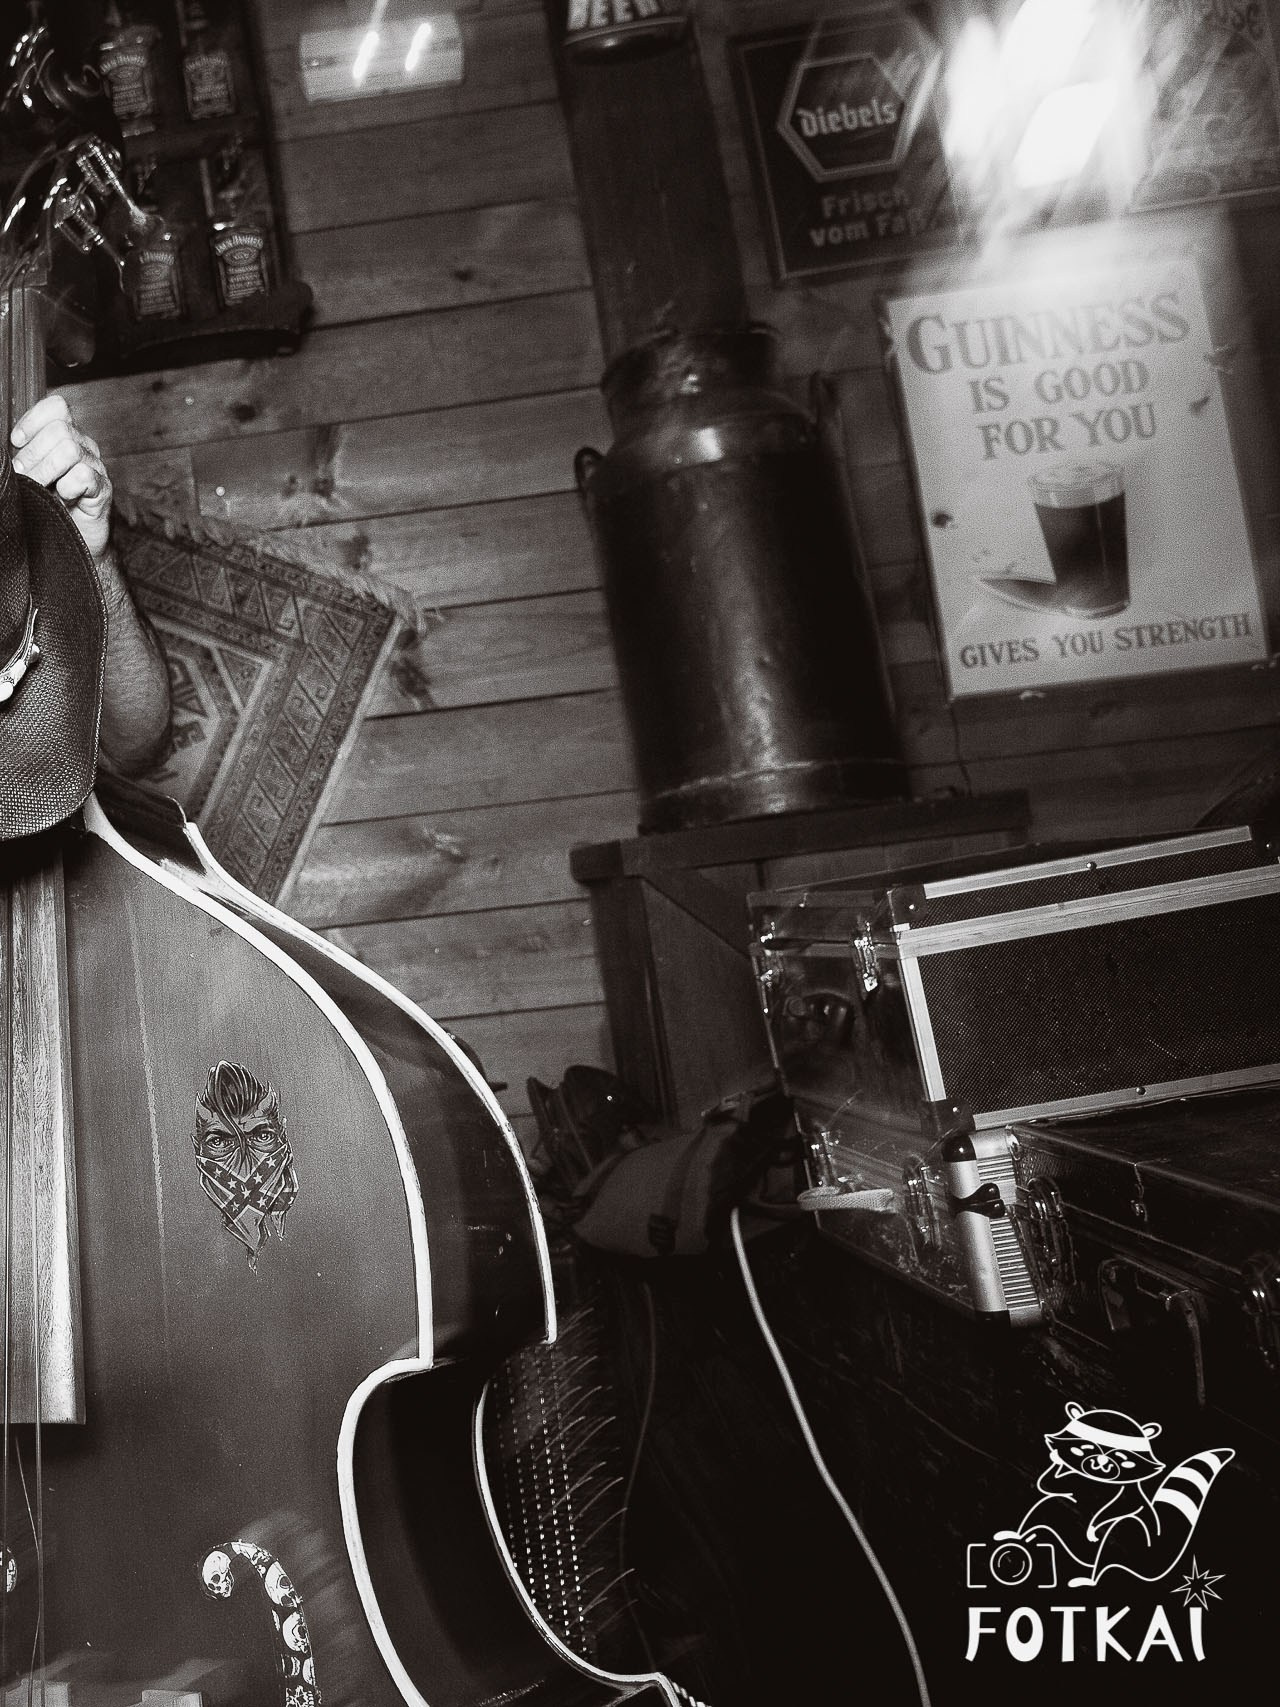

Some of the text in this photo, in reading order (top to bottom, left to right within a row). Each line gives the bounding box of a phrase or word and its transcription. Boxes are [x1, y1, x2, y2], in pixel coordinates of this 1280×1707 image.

[795, 98, 899, 138] Diebels
[809, 219, 871, 248] vom
[905, 291, 1191, 375] GUINNESS
[967, 358, 1151, 415] IS GOOD
[978, 402, 1159, 461] FOR YOU
[959, 612, 1253, 670] GIVES YOU STRENGTH
